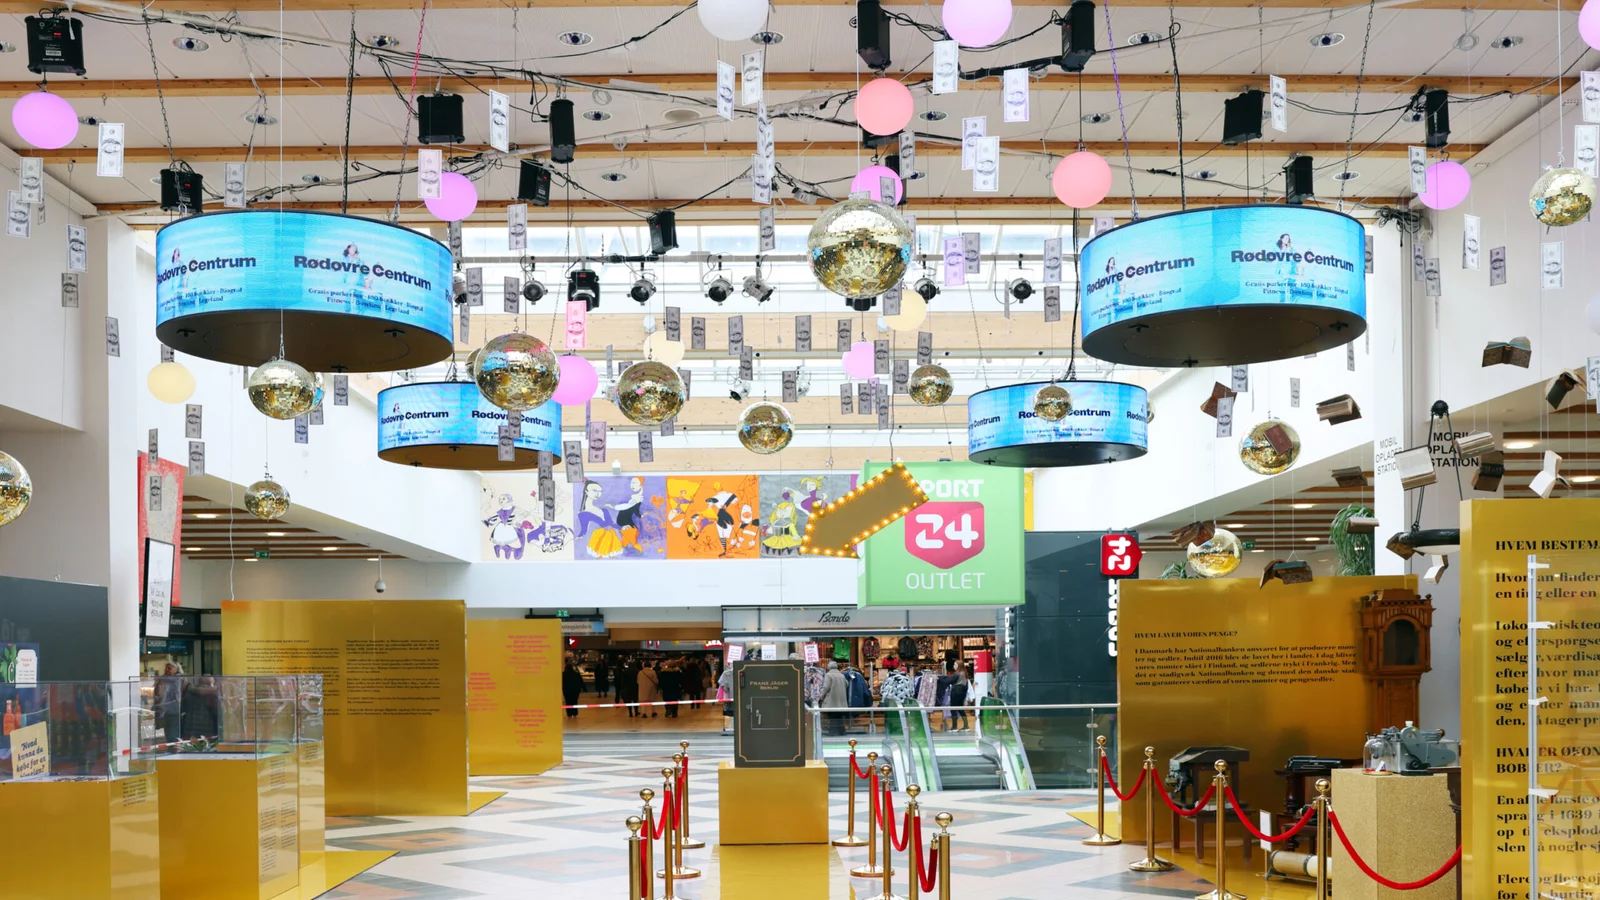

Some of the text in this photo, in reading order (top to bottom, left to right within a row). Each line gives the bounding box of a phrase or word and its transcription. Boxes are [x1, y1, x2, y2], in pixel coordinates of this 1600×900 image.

[189, 256, 256, 272] Centrum
[1231, 249, 1354, 272] Rødovre Centrum
[293, 255, 431, 290] Rødovre Centrum
[1086, 256, 1194, 295] Rødovre Centrum
[405, 410, 449, 420] Centrum
[471, 410, 508, 419] Rødov
[974, 415, 1000, 427] Centrum
[1380, 436, 1397, 449] MOBIL
[1377, 462, 1396, 475] STATIO
[919, 479, 984, 498] PORT
[915, 513, 979, 549] 24
[1496, 541, 1536, 550] HVEM
[906, 572, 985, 589] OUTLET
[1496, 572, 1554, 582] Hvoran
[1516, 588, 1542, 600] tig
[1546, 588, 1577, 598] eller
[818, 611, 850, 622] Bonde
[1496, 621, 1500, 630] I
[1496, 638, 1513, 649] og
[1496, 652, 1544, 664] sælgr,
[1496, 668, 1528, 678] efter
[1536, 668, 1567, 677] hvor
[1496, 683, 1592, 694] købee vi har.
[1496, 700, 1600, 712] og eder man
[1496, 716, 1525, 726] den,
[1545, 717, 1581, 727] tager
[21, 738, 37, 750] Hvad
[1496, 748, 1529, 757] HVA
[1539, 747, 1557, 756] ER
[30, 759, 38, 769] for
[1497, 763, 1561, 773] BOBER?
[1497, 796, 1514, 804] En
[1517, 795, 1529, 804] af
[1497, 810, 1592, 823] sprag i 1639
[1497, 829, 1514, 839] op
[1497, 842, 1525, 852] slen
[1548, 842, 1586, 853] nogle
[1498, 874, 1530, 884] Flere
[1498, 890, 1517, 900] for
